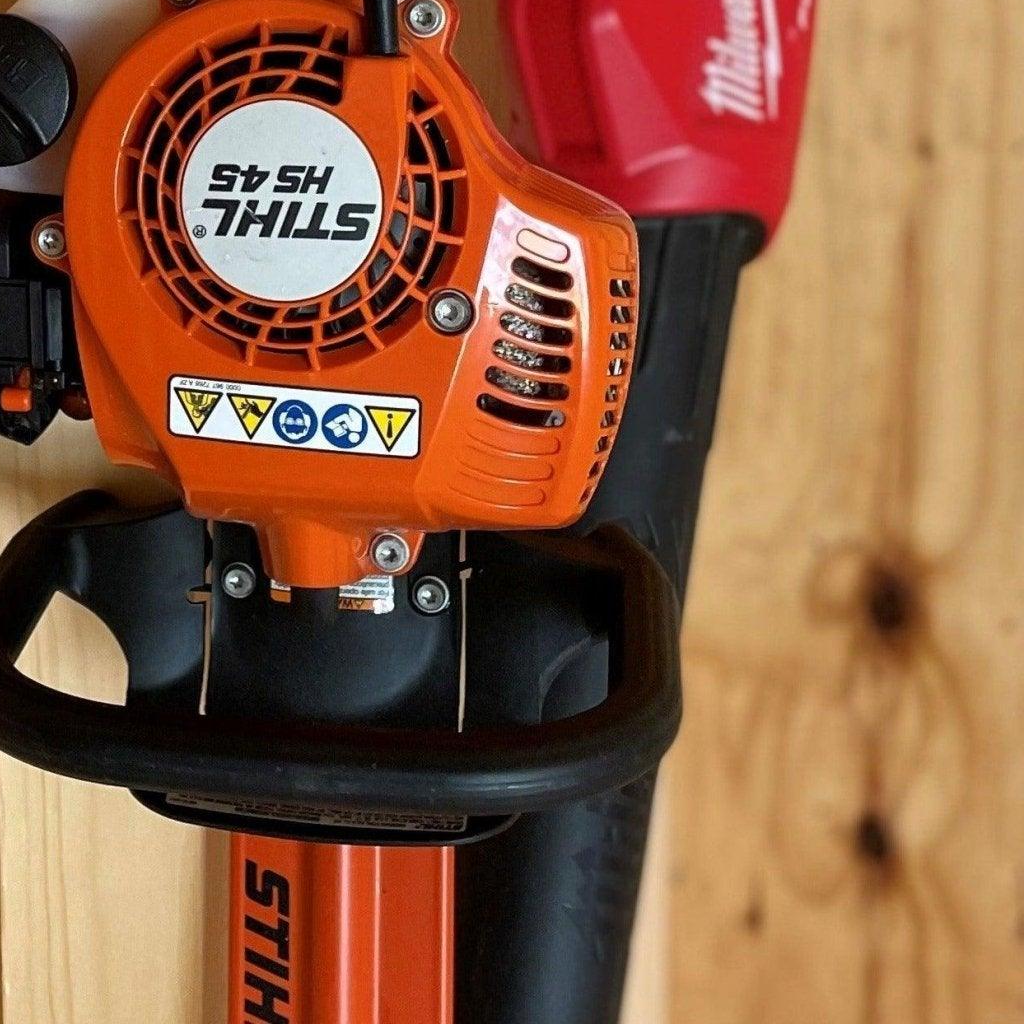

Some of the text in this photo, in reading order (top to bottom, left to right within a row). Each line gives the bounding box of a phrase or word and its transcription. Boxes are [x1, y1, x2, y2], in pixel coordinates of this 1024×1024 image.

[208, 163, 334, 194] HS 45
[244, 859, 290, 1024] STIH
